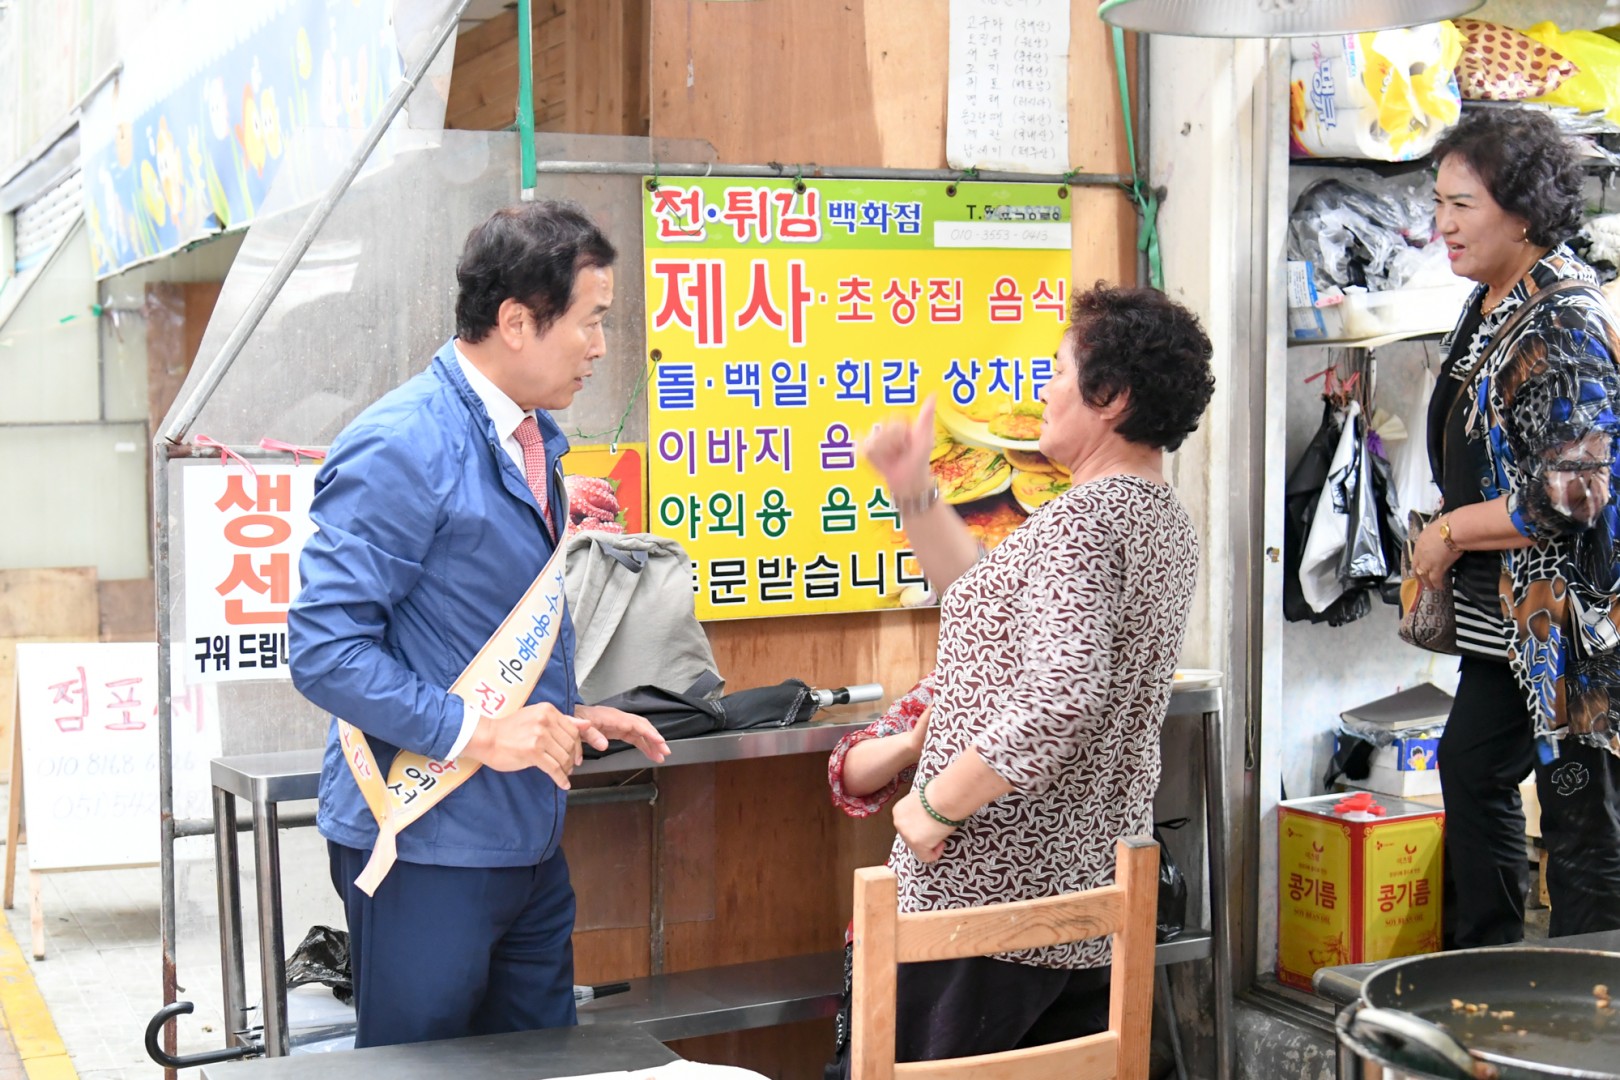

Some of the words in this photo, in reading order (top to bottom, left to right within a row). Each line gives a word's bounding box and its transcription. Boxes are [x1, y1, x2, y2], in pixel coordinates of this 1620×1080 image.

[828, 201, 921, 234] 백화점
[988, 277, 1066, 322] 음식
[658, 427, 793, 475] 이바지
[659, 488, 793, 539] 야외용
[214, 474, 293, 626] 생선
[691, 551, 930, 605] 문받습니다
[194, 634, 230, 673] 구워
[1288, 872, 1338, 910] 콩기름
[1377, 878, 1432, 913] 콩기름
